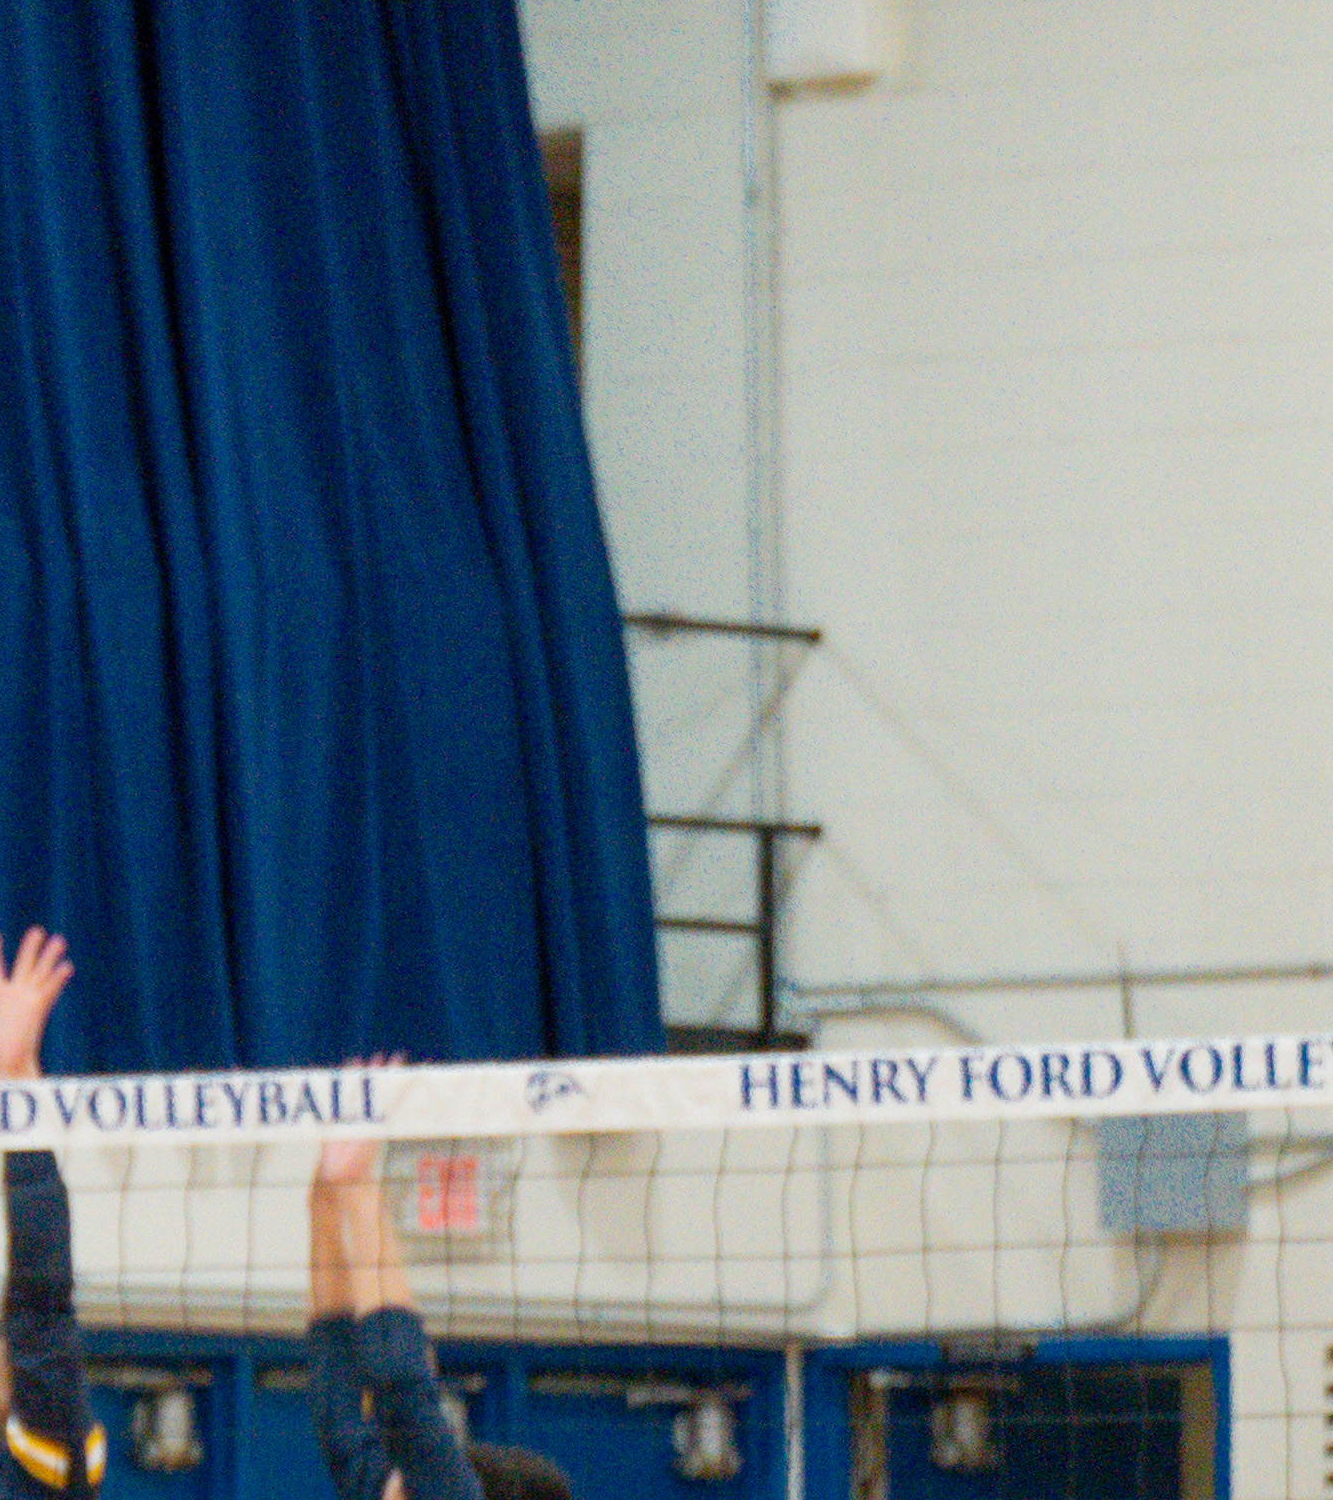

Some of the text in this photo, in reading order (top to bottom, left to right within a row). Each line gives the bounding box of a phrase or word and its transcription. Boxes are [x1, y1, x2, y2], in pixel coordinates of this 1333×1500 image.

[52, 1076, 386, 1132] VOLLEYBALL
[739, 1039, 1333, 1108] HENRY FORD VOLLE
